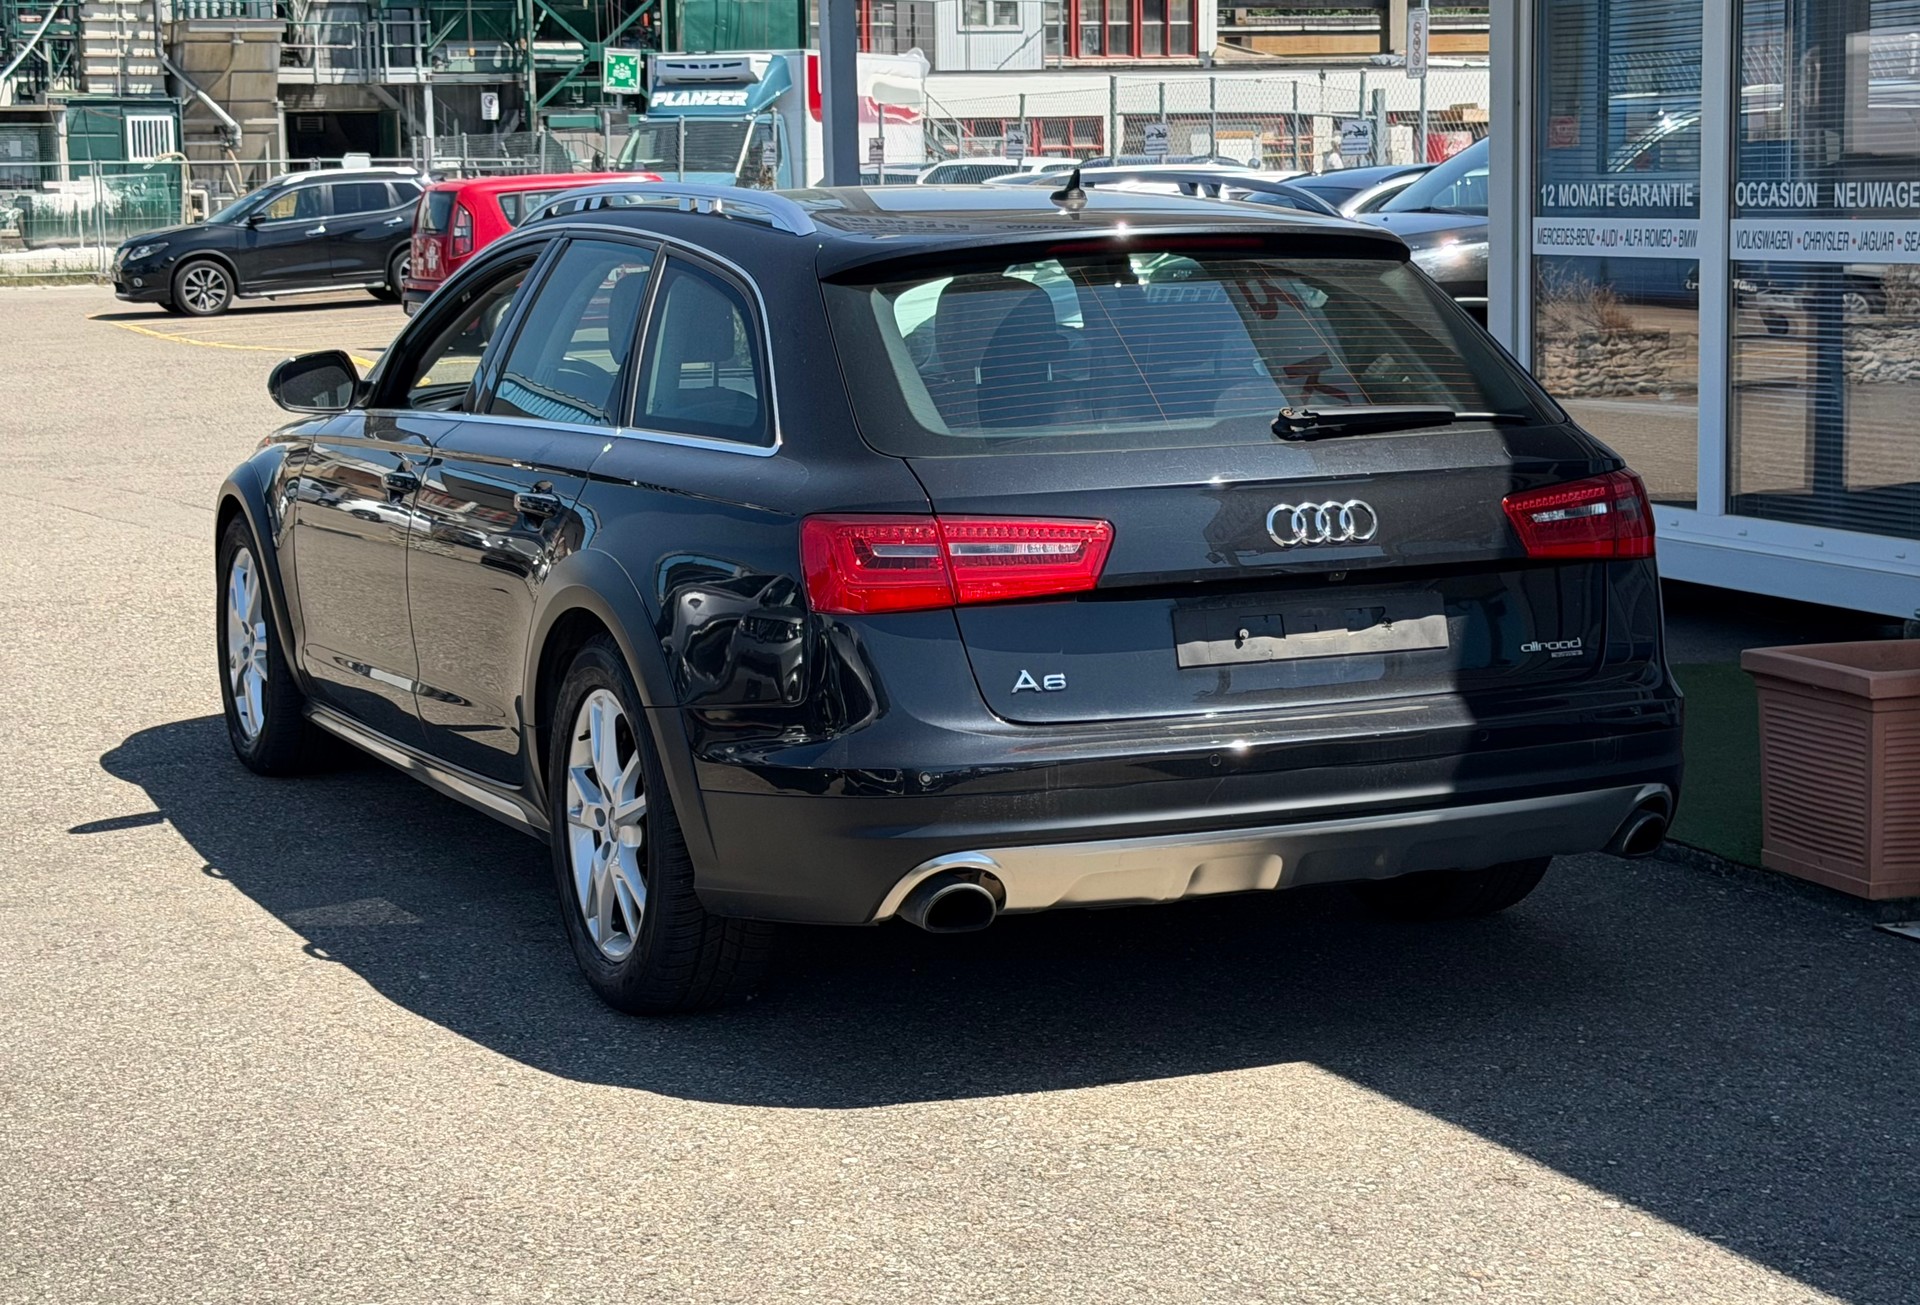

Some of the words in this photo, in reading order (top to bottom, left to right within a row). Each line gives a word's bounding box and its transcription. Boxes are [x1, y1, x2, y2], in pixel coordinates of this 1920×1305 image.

[650, 91, 749, 107] PLANZER
[1541, 183, 1555, 207] 12
[1558, 183, 1616, 207] MONATE
[1618, 182, 1694, 207] GARANTIE
[1735, 181, 1818, 208] OCCASION
[1834, 181, 1920, 208] NEUWAGE
[1537, 227, 1596, 246] MERCEDES-BENZ
[1600, 229, 1619, 247] AUDI
[1624, 228, 1643, 248] ALFA
[1644, 228, 1672, 248] ROMEO
[1678, 229, 1699, 248] BMW
[1736, 230, 1794, 250] VOLKSWAGEN
[1802, 230, 1850, 251] CHRYSLER
[1857, 231, 1895, 251] JAGUAR
[1520, 636, 1582, 653] allroad
[1011, 669, 1067, 694] A6
